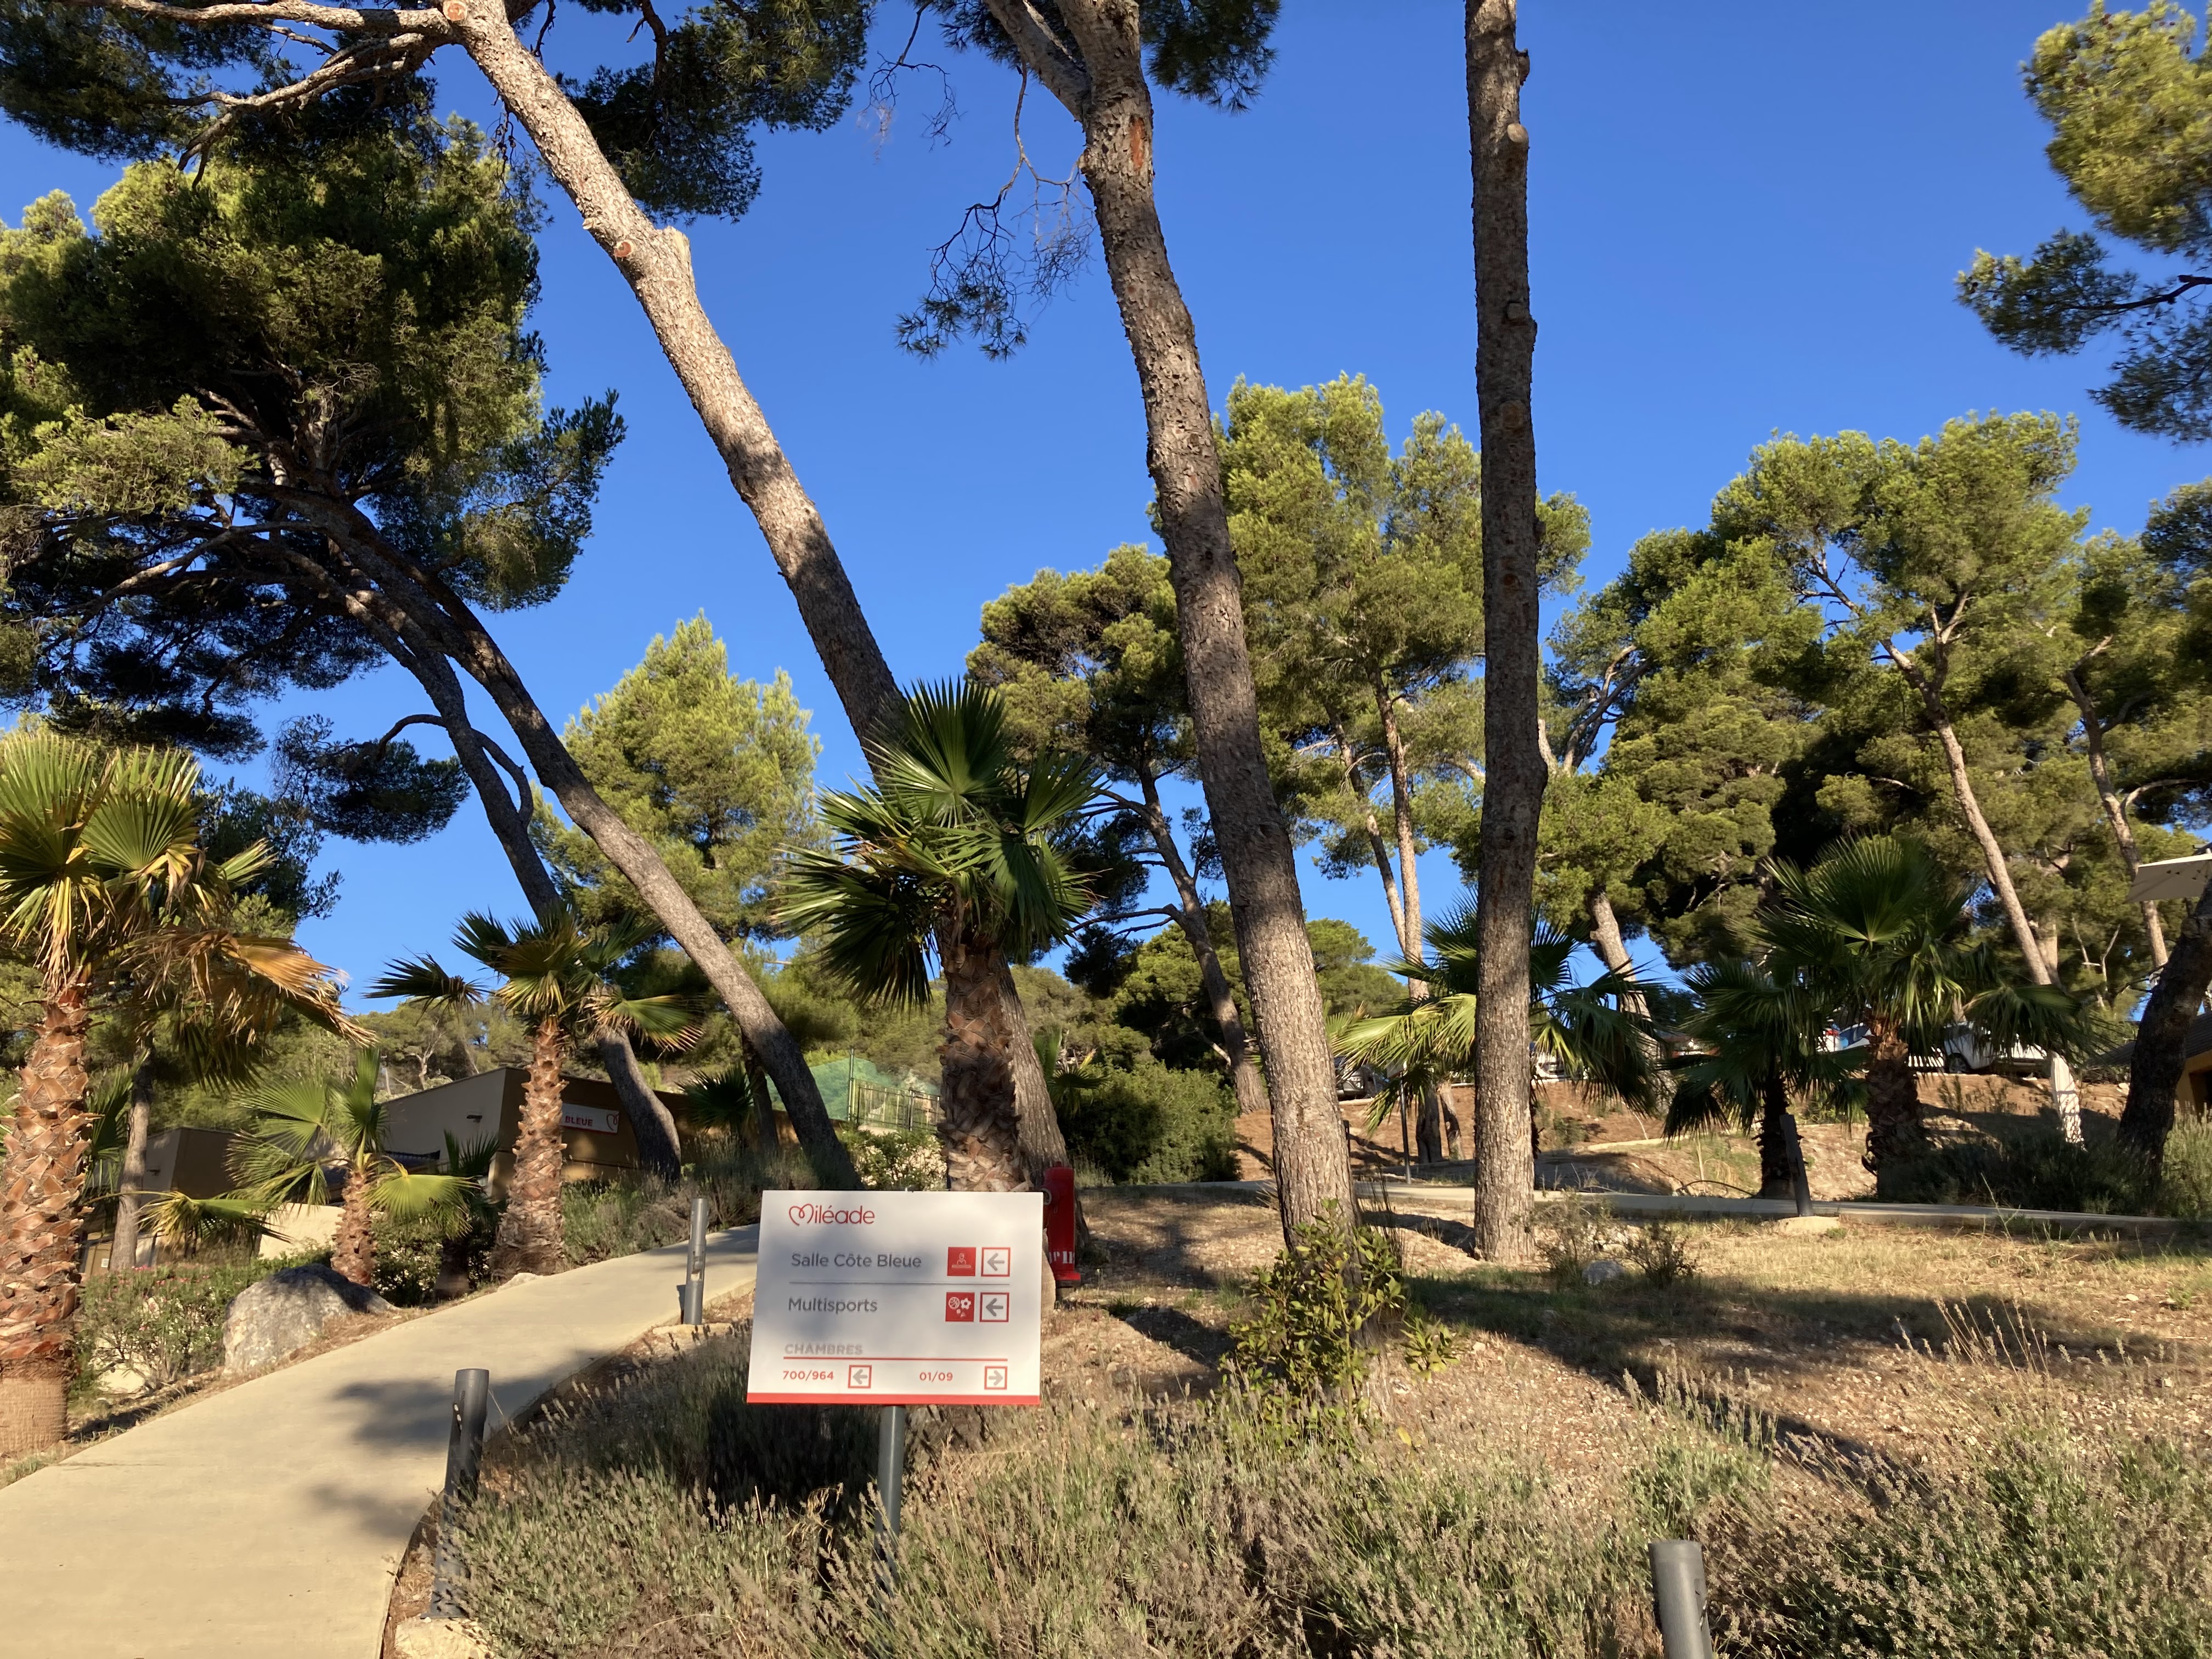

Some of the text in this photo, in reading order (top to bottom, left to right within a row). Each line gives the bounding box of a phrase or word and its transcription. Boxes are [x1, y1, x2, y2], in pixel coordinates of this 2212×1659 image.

[565, 1115, 593, 1126] BLEUE
[789, 1204, 875, 1226] Miléade
[791, 1251, 922, 1268] Salle Côte Bleue
[788, 1297, 878, 1314] Multisports
[784, 1343, 863, 1355] CHAMBRES
[783, 1370, 834, 1380] 700/964
[919, 1371, 953, 1382] 01/09
